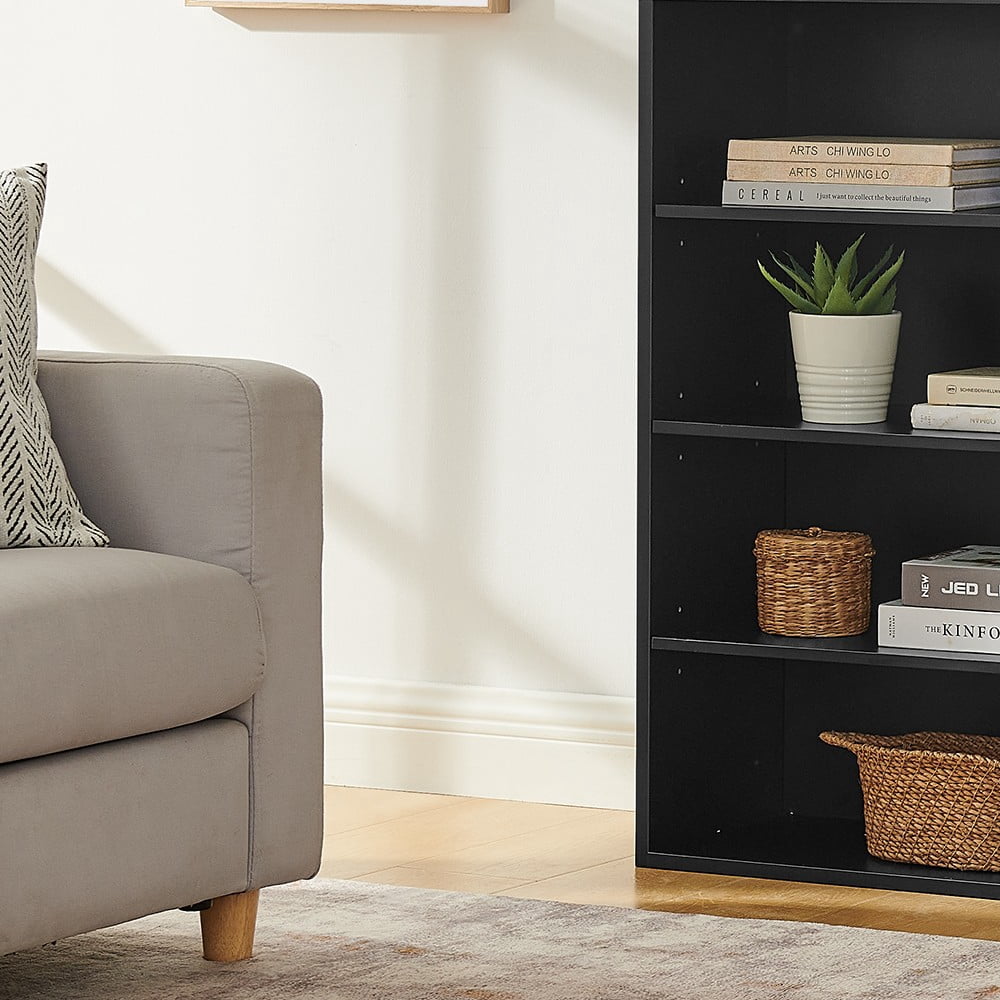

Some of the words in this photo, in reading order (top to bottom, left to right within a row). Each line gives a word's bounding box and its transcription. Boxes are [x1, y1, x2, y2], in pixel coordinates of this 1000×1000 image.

[790, 146, 818, 156] ARTS
[826, 146, 844, 156] CHI
[846, 146, 874, 157] WING
[877, 148, 891, 157] LO
[788, 168, 816, 177] ARTS
[826, 168, 843, 178] CHI
[846, 169, 873, 179] WING
[876, 170, 889, 180] LO
[738, 188, 804, 201] CEREAL
[921, 574, 929, 598] NEW
[942, 582, 978, 596] JED
